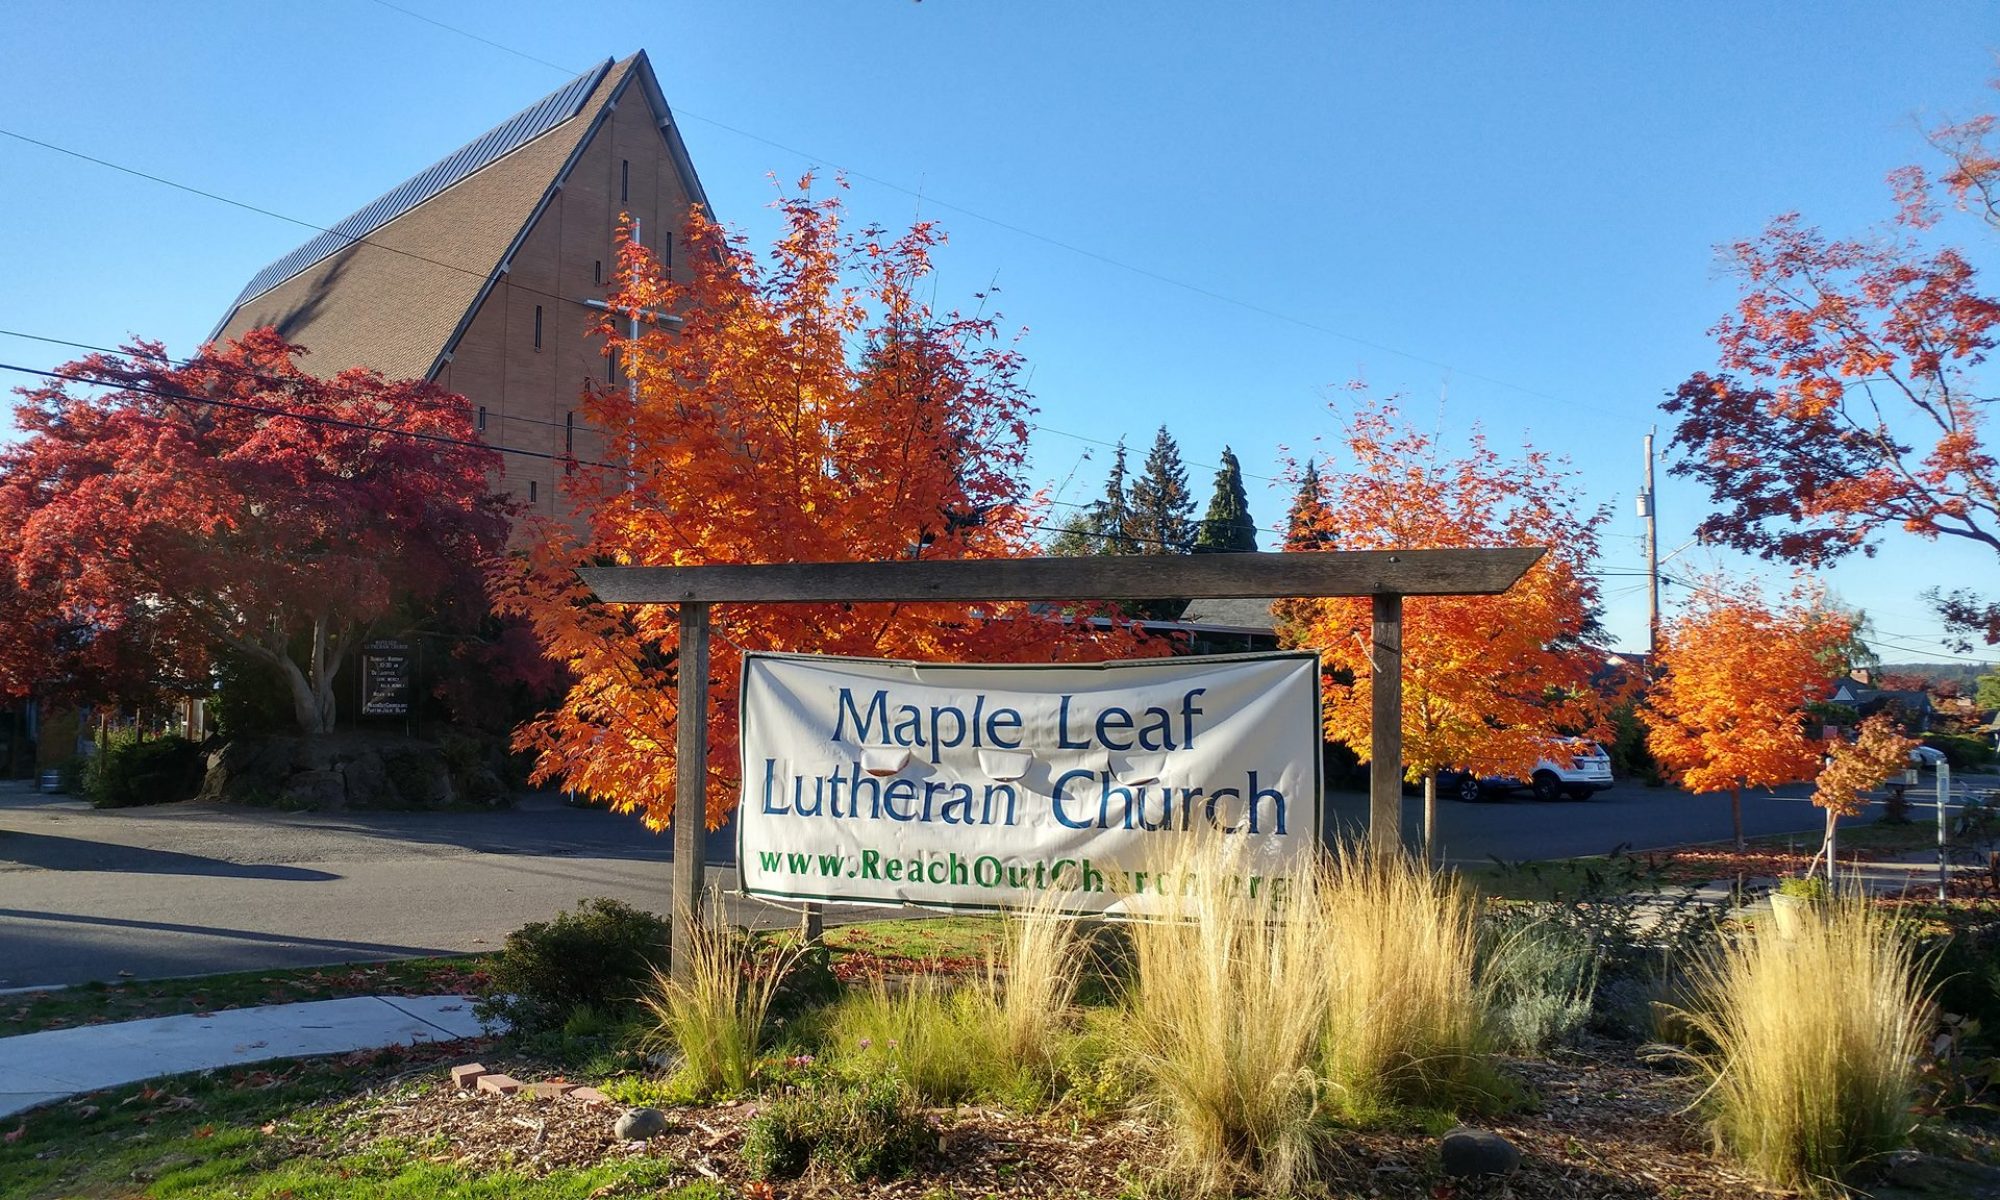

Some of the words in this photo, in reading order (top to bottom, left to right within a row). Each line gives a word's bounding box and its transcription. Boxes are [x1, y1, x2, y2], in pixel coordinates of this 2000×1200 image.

[830, 687, 1023, 764] Maple
[1057, 687, 1208, 751] Leaf
[762, 758, 1018, 826] Lutheran
[1051, 768, 1288, 835] Church
